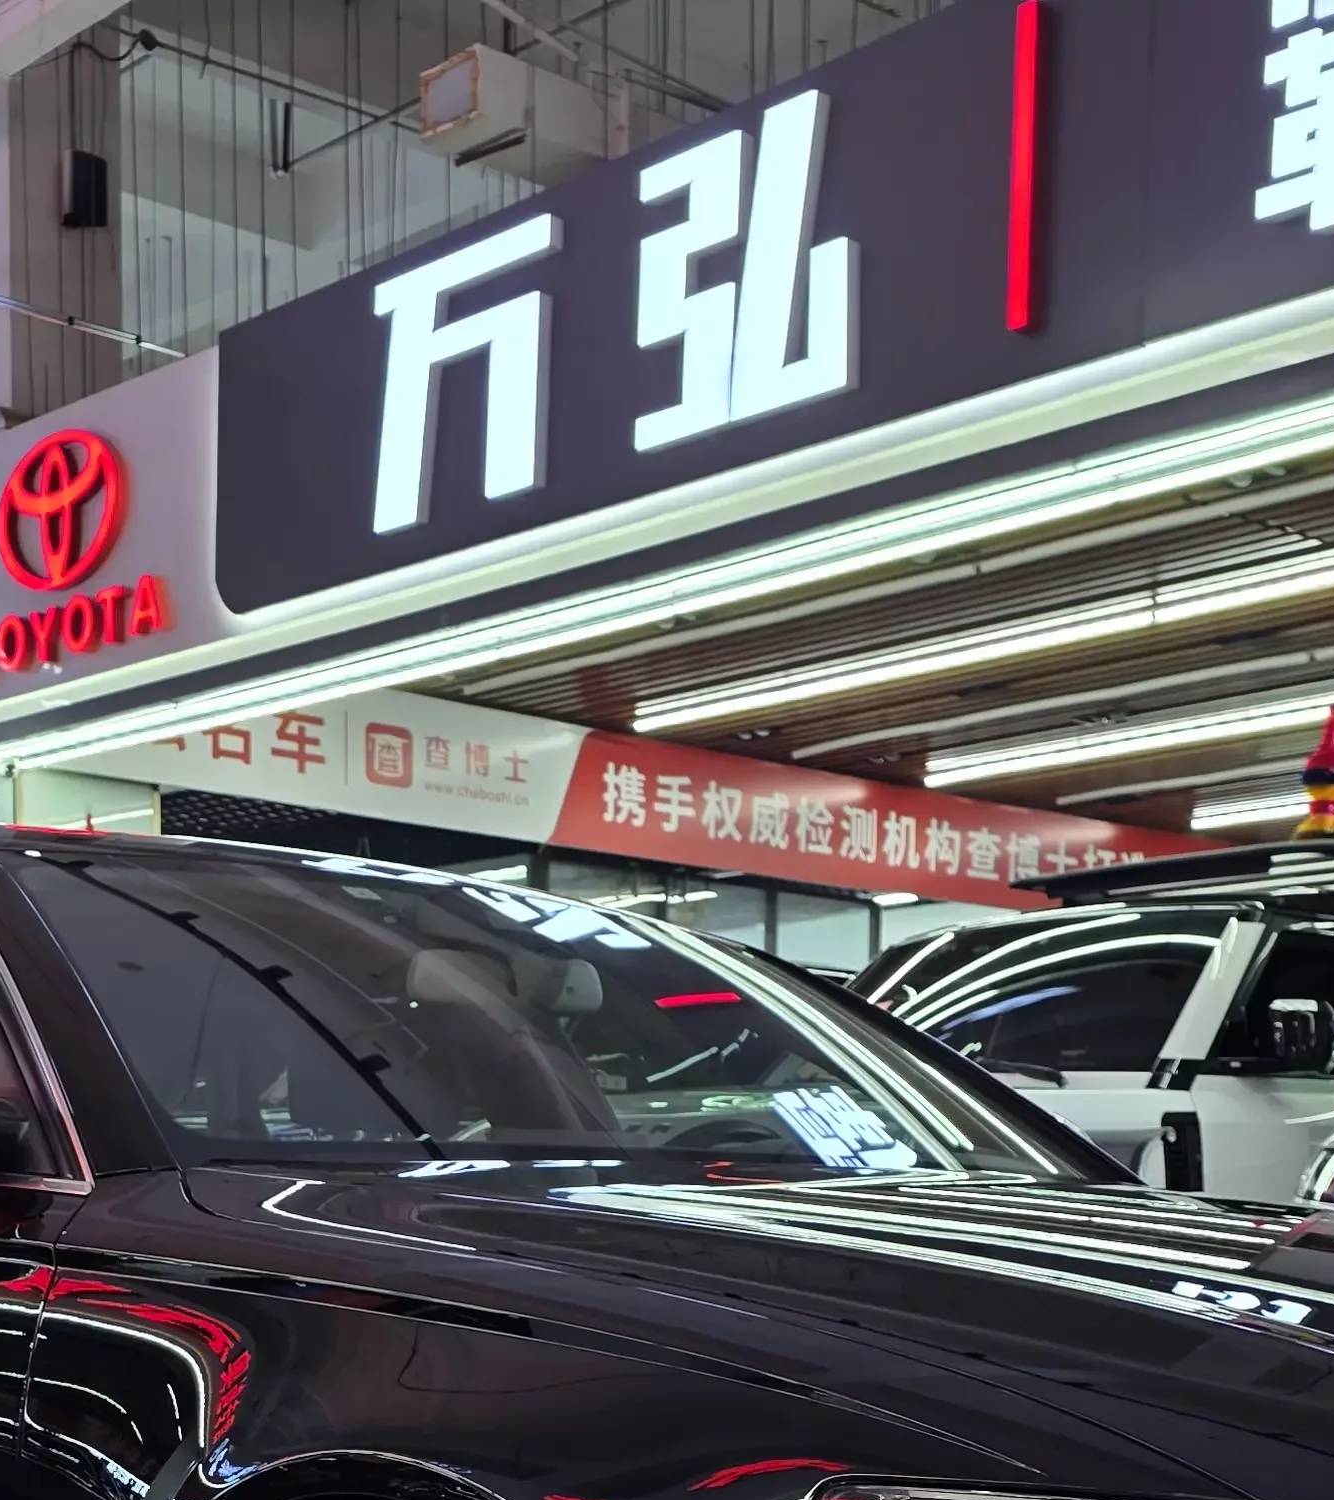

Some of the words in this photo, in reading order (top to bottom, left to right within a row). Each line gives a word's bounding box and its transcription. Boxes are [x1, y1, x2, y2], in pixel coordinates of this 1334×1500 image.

[373, 89, 860, 535] 万弘
[152, 711, 326, 774] 名车
[424, 735, 530, 784] 查博士
